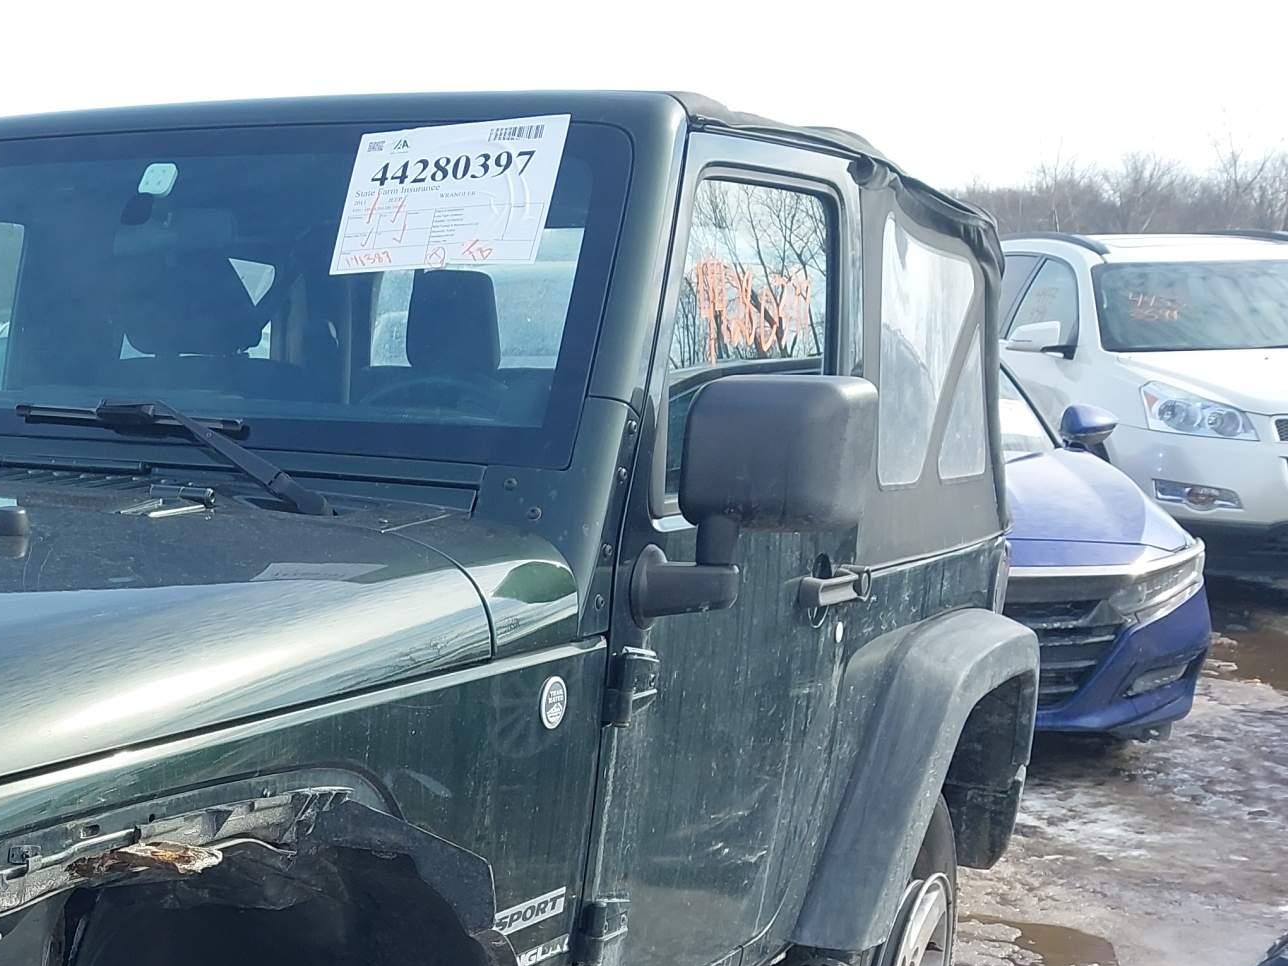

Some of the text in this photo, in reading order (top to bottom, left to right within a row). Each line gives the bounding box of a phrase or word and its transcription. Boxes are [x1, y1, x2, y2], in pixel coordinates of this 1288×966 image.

[371, 150, 536, 186] 44280397
[400, 184, 441, 194] Insurance
[495, 893, 565, 931] SPORT
